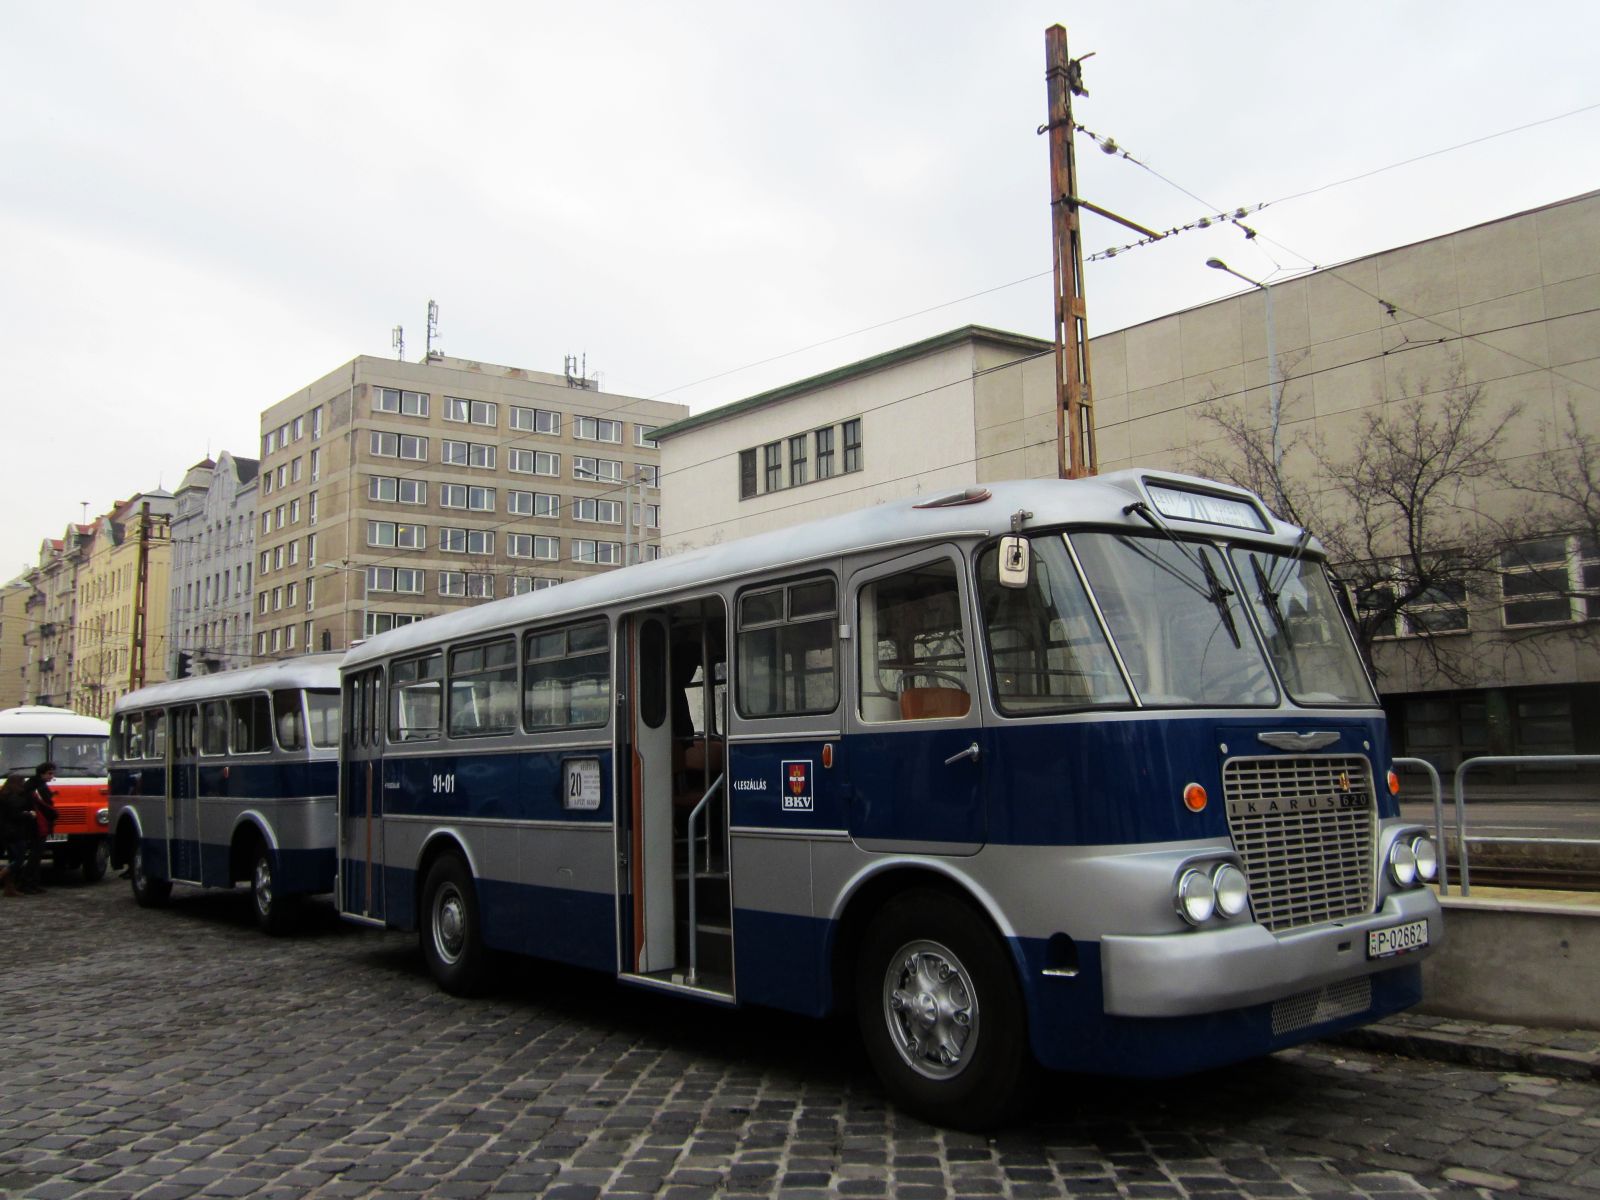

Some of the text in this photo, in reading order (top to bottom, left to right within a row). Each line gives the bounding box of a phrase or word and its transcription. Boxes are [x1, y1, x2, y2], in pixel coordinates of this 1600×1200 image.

[570, 772, 582, 797] 20
[737, 778, 767, 791] LESZÁLLÁS
[784, 796, 811, 808] BKV
[1231, 795, 1367, 814] IKARUS 620
[1378, 923, 1422, 952] P-02662
